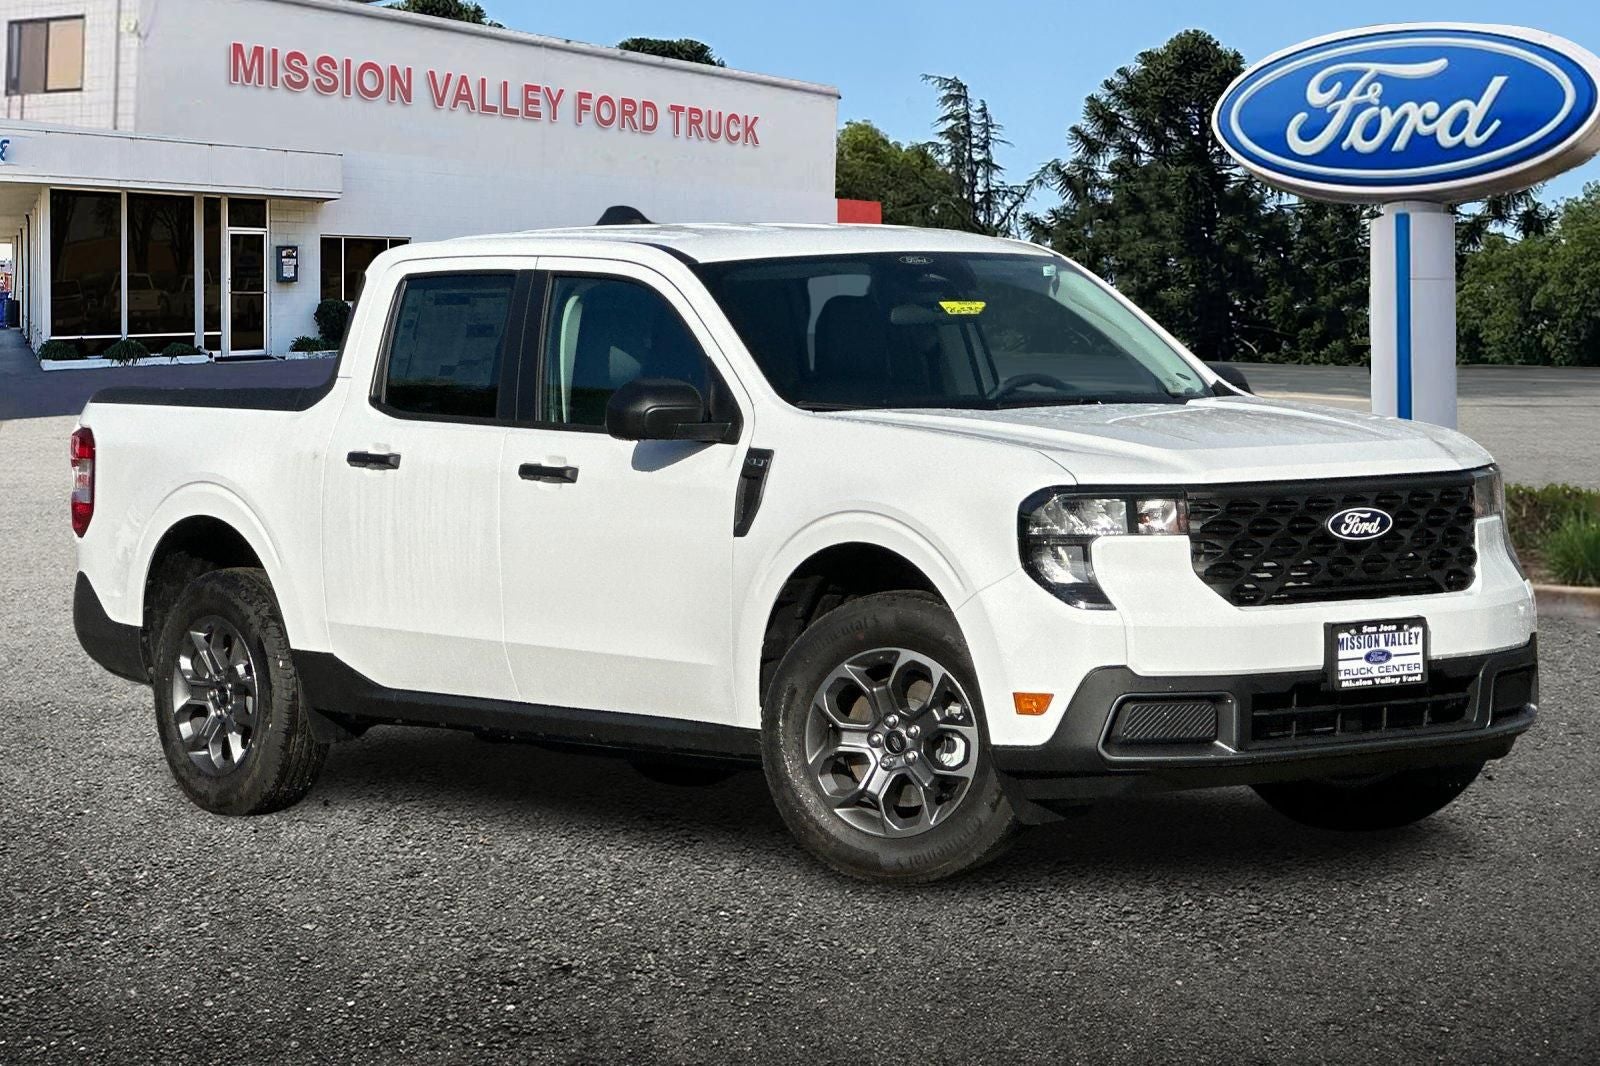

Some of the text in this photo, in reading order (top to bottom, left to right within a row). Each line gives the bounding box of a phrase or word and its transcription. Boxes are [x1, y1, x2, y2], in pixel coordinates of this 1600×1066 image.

[229, 41, 761, 147] MISSION VALLEY FORD TRUCK
[1286, 57, 1509, 156] Ford
[1340, 512, 1381, 535] Ford
[1338, 631, 1420, 651] MISSION VALLEY
[1369, 651, 1388, 662] Ford
[1338, 663, 1421, 677] TRUCK CENTER
[1341, 674, 1422, 687] Mission Valley Ford
